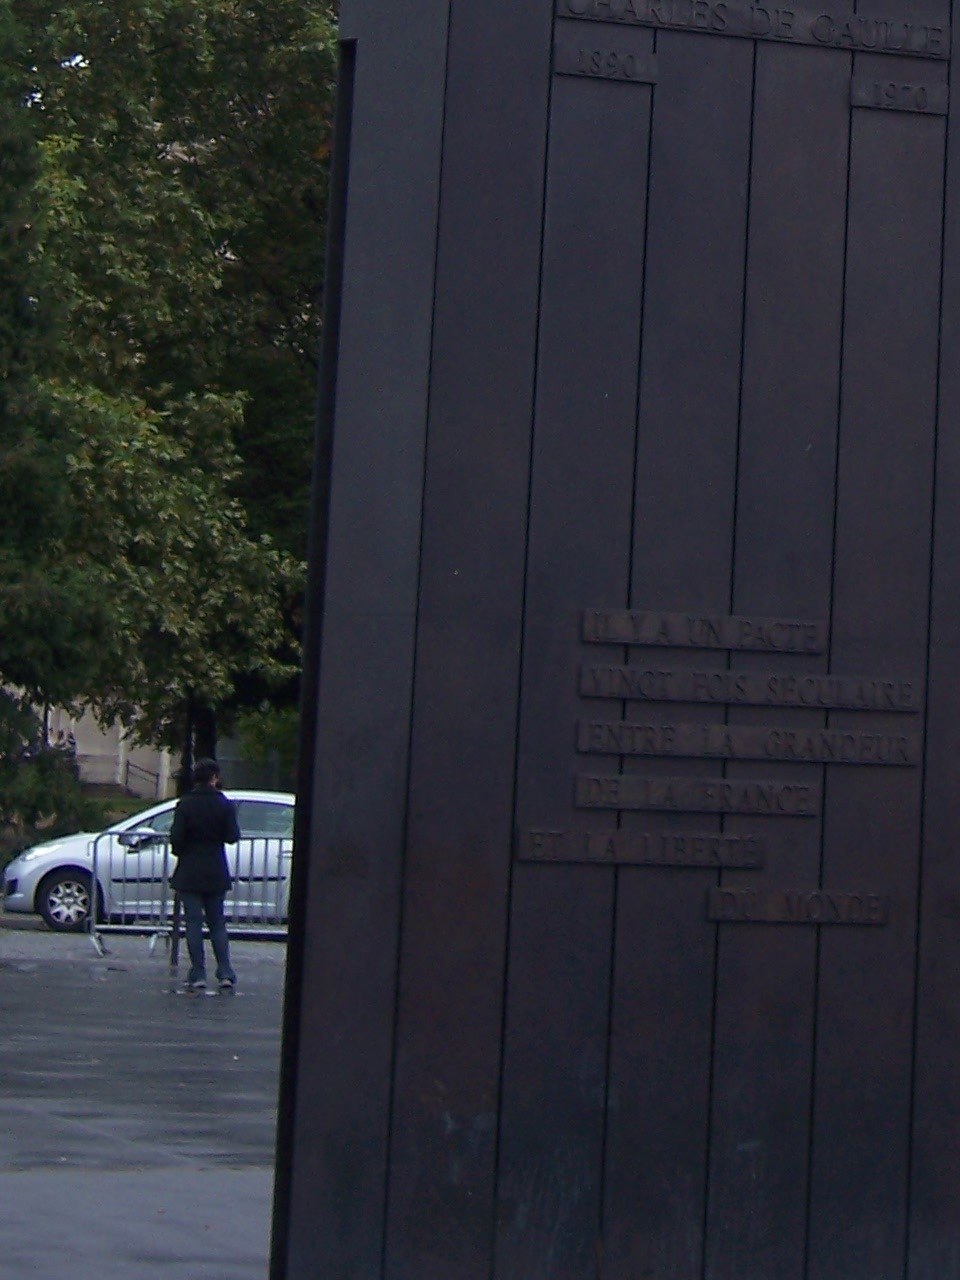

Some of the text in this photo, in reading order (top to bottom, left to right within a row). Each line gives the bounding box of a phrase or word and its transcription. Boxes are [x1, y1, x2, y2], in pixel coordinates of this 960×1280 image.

[750, 6, 794, 38] DE
[811, 14, 942, 55] GAULLE
[577, 50, 635, 78] 1890
[871, 81, 928, 109] 1970
[688, 616, 723, 648] UN
[738, 617, 818, 651] PACTE
[690, 671, 746, 703] FOIS
[587, 722, 909, 762] ENTRE LA GRANDEUR
[584, 776, 620, 808] DE
[704, 782, 812, 813] FRANCE
[783, 890, 881, 922] MONDE
